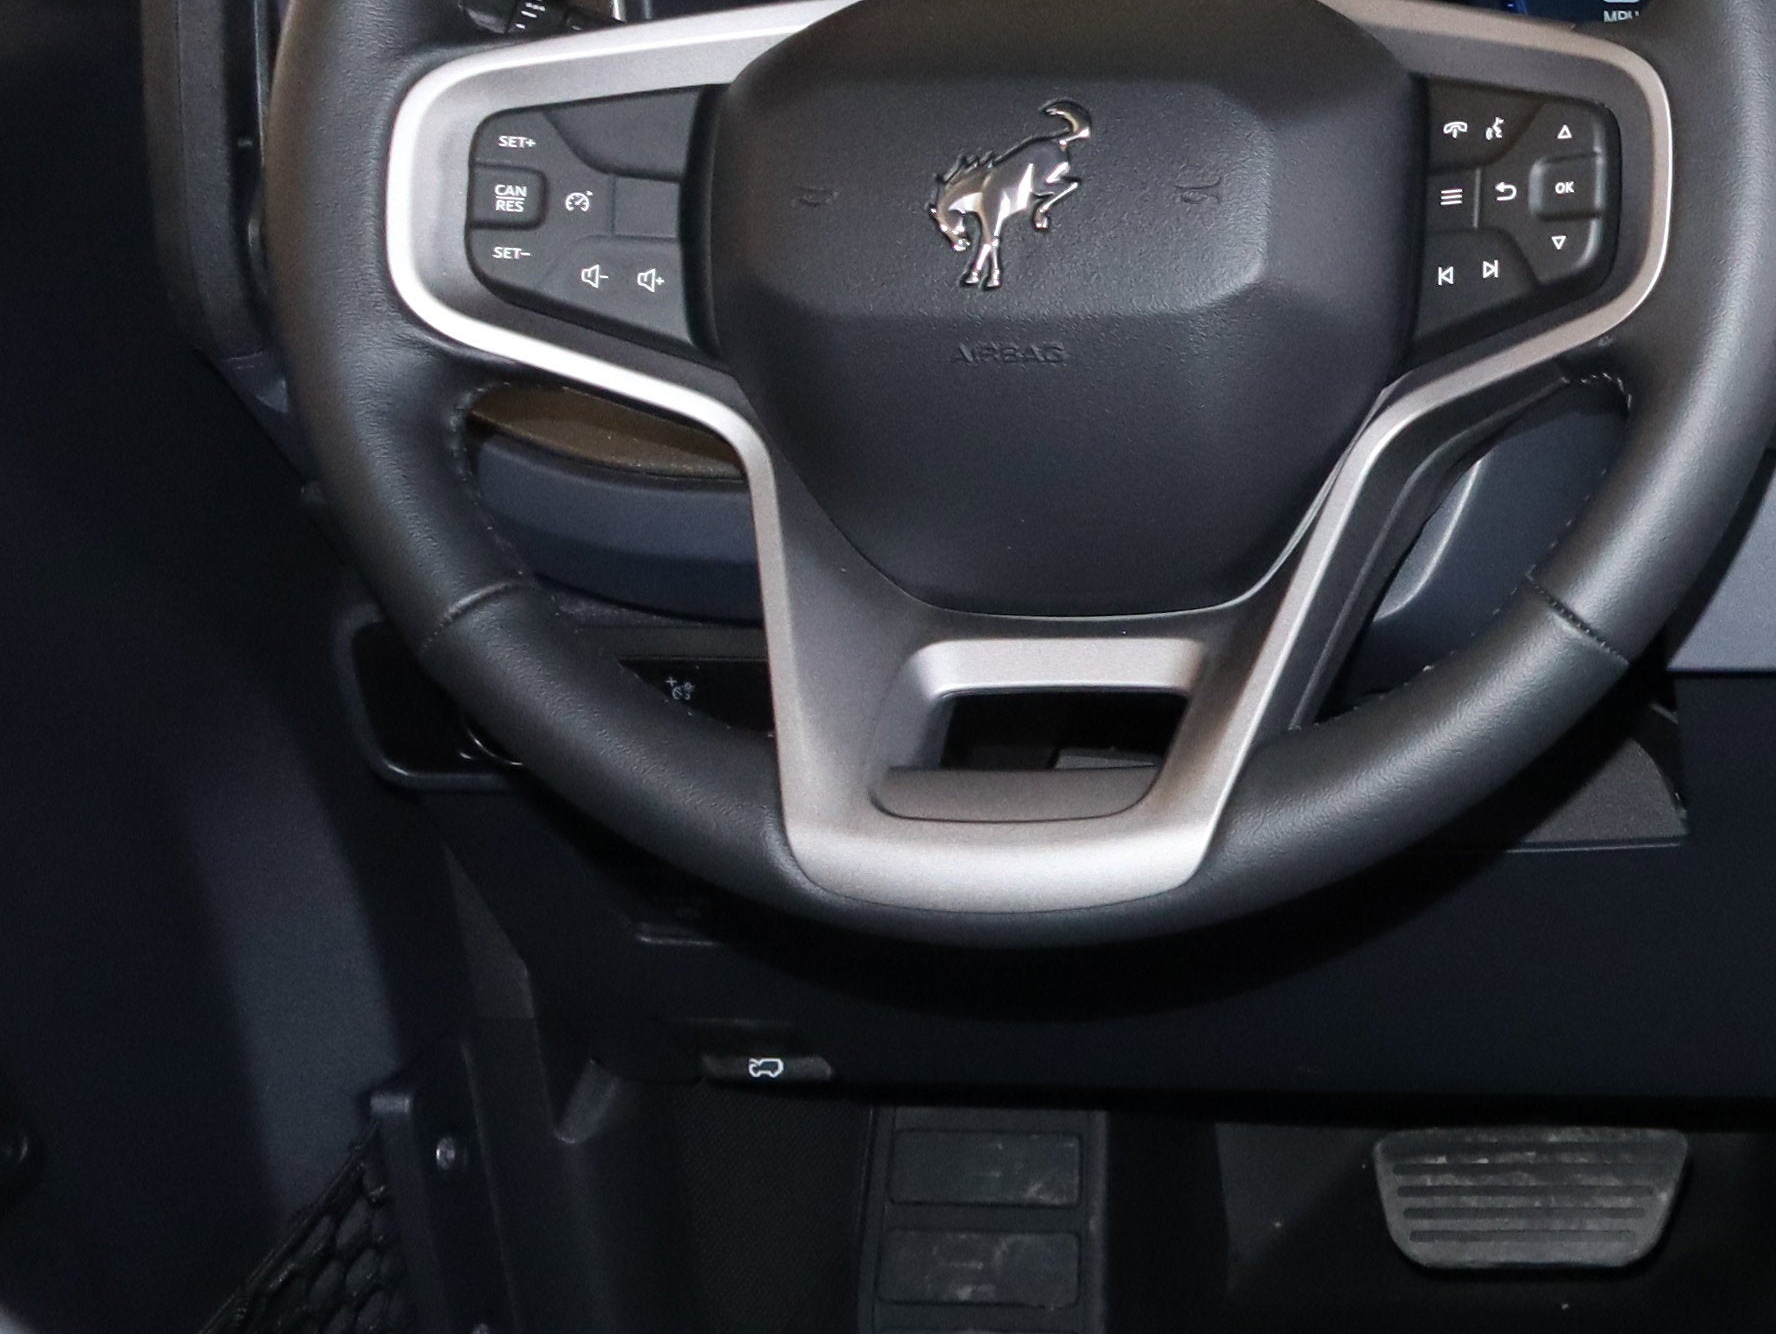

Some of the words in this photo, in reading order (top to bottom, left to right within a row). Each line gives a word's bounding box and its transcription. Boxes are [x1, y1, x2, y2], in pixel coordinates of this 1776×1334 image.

[495, 185, 527, 197] CAN
[1556, 182, 1575, 193] OK
[496, 201, 524, 212] RES
[951, 341, 1065, 365] AIRBAG
